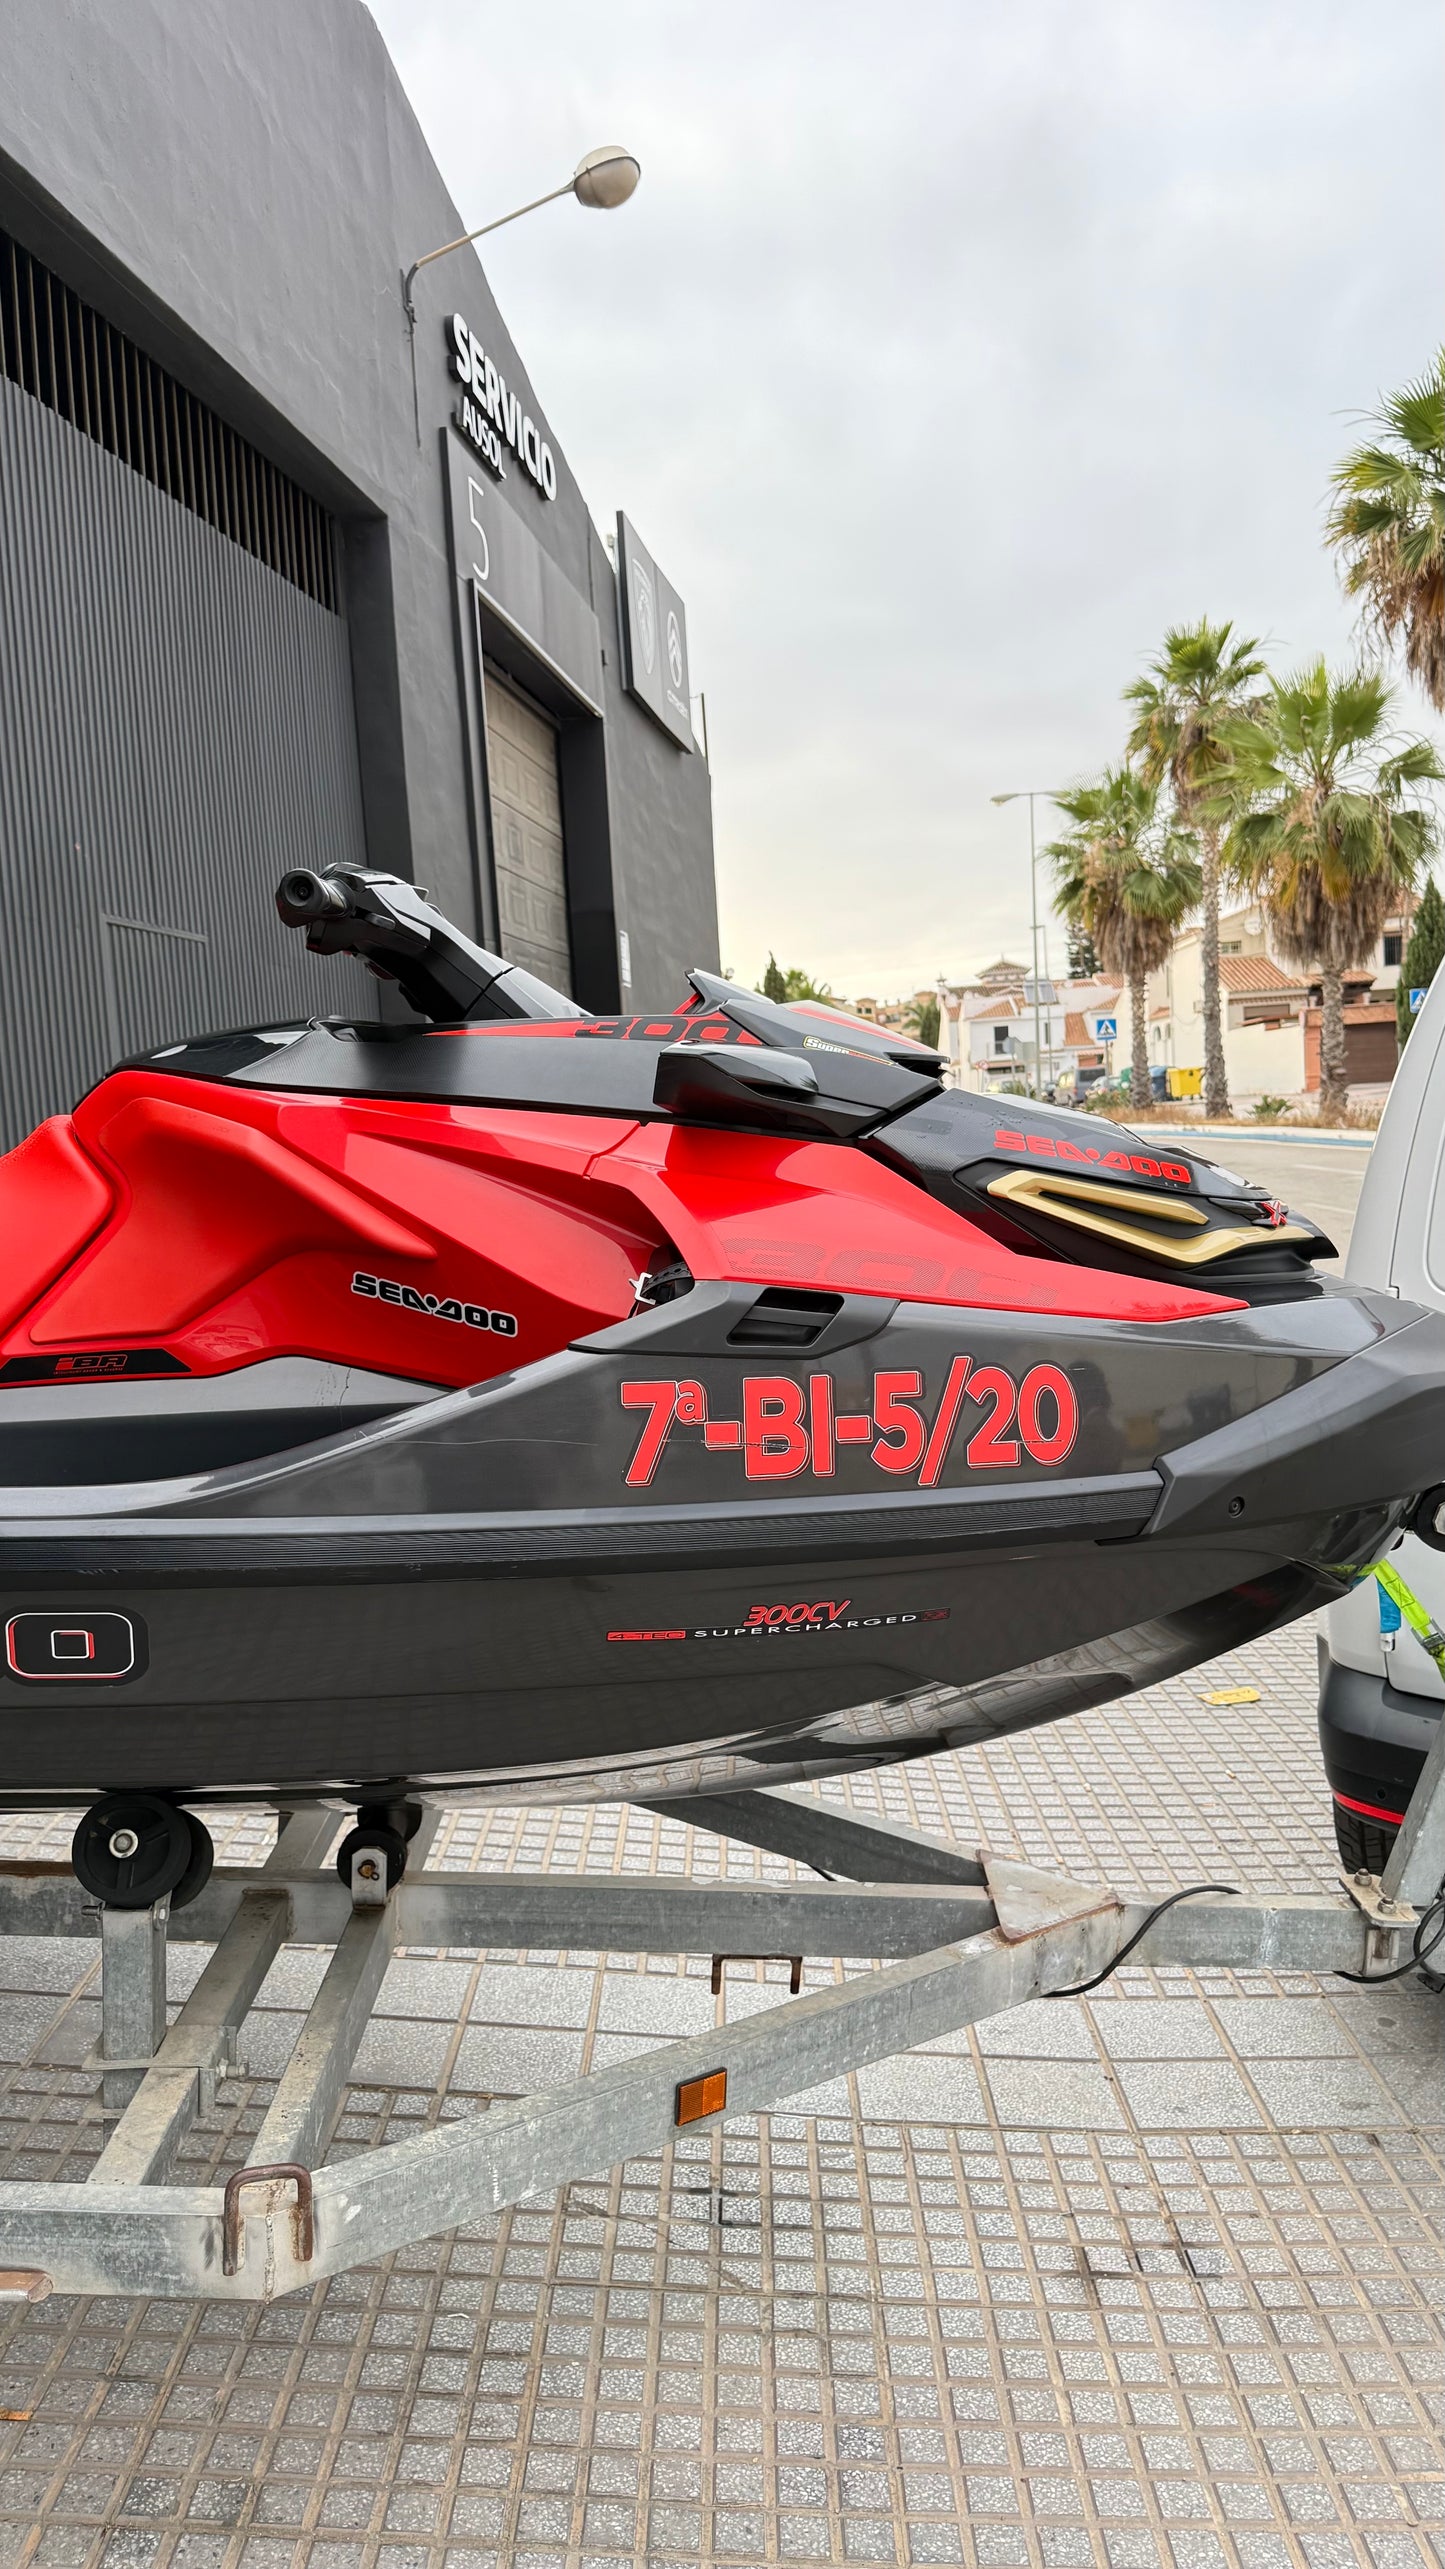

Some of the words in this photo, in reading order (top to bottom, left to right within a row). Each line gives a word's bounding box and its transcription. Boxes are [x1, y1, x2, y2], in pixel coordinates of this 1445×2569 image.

[452, 313, 557, 501] SERVICIO
[462, 396, 506, 479] AUSOL
[467, 476, 490, 581] 5
[694, 1614, 917, 1638] SUPERCHARGED
[743, 1600, 852, 1626] 300CV
